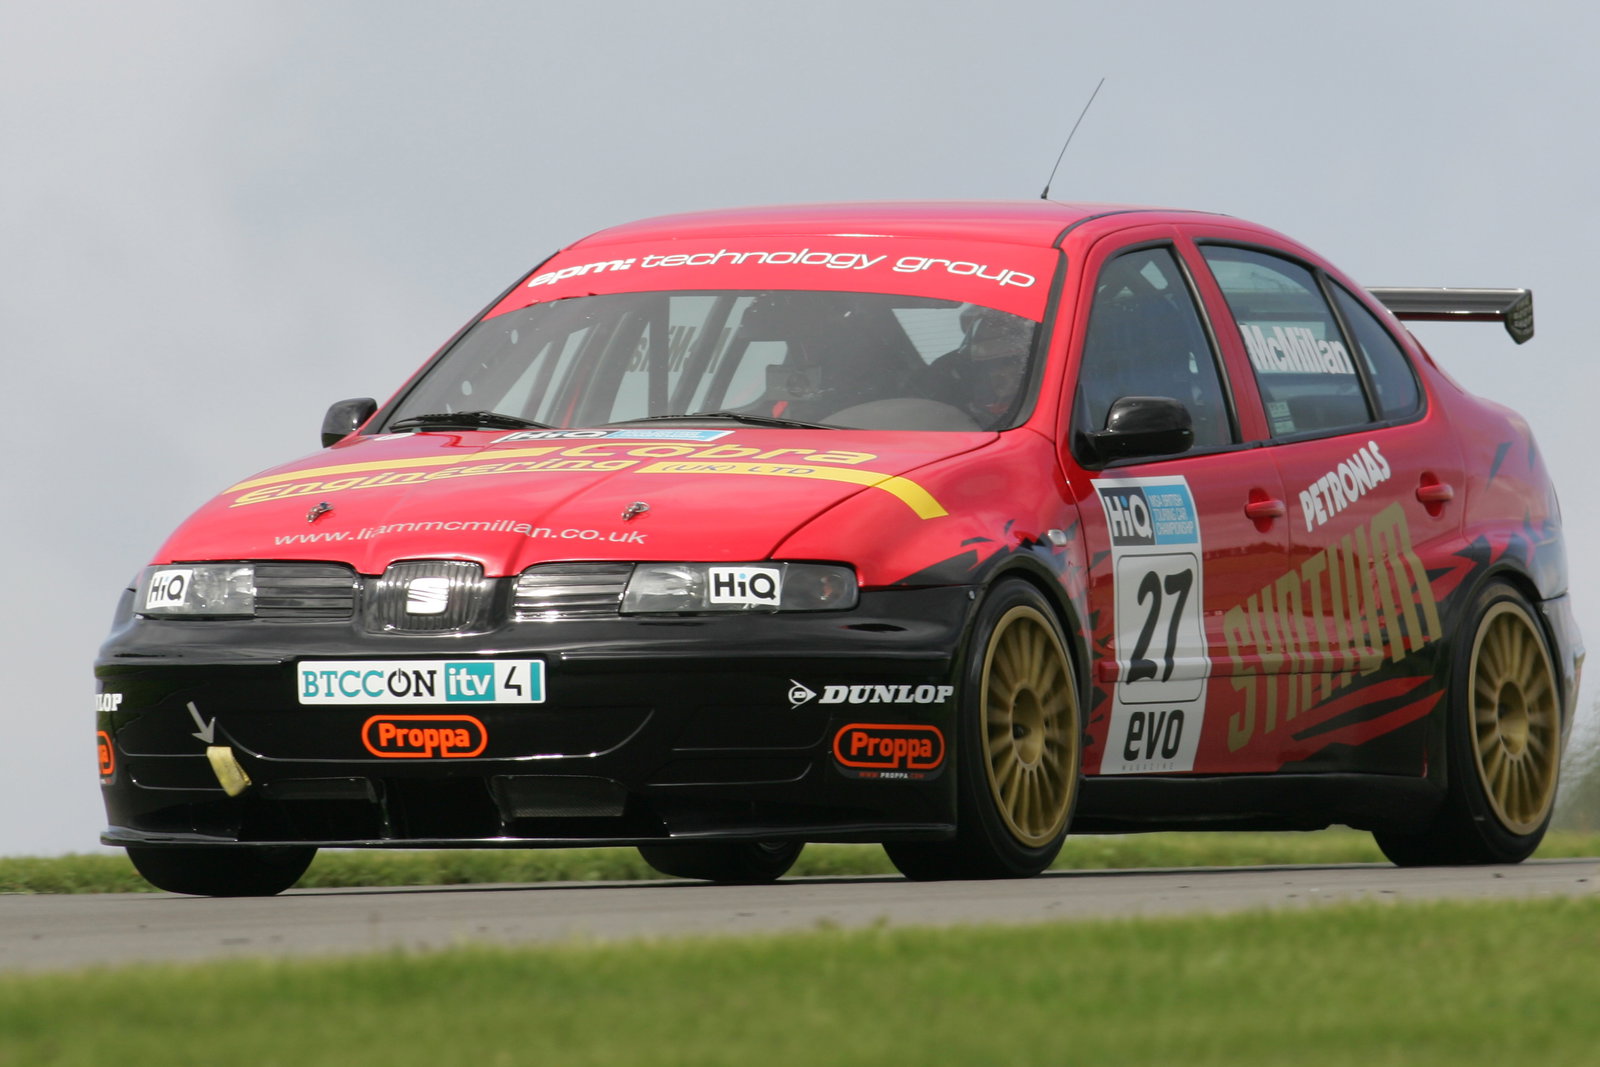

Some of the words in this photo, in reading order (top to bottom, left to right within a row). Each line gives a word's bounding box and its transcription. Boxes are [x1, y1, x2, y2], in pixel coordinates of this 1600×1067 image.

[527, 257, 637, 288] epm:
[641, 248, 888, 270] technology
[892, 256, 1036, 288] group
[1238, 324, 1356, 375] McMillan
[560, 442, 879, 466] Cobra
[231, 458, 641, 507] Engineering
[747, 465, 816, 475] LTD
[1298, 440, 1391, 533] PETRONAS
[274, 518, 648, 546] www.liammcmillan.co.uk
[1103, 494, 1153, 539] HiQ
[149, 574, 184, 602] HiQ
[712, 571, 778, 602] HiQ
[1125, 567, 1194, 686] 27
[1223, 501, 1443, 753] SYNTIUM
[448, 667, 491, 696] itv
[503, 666, 523, 696] 4
[818, 685, 954, 704] DUNLOP
[377, 722, 471, 756] Proppa
[850, 731, 933, 766] Proppa
[1123, 709, 1185, 762] evo
